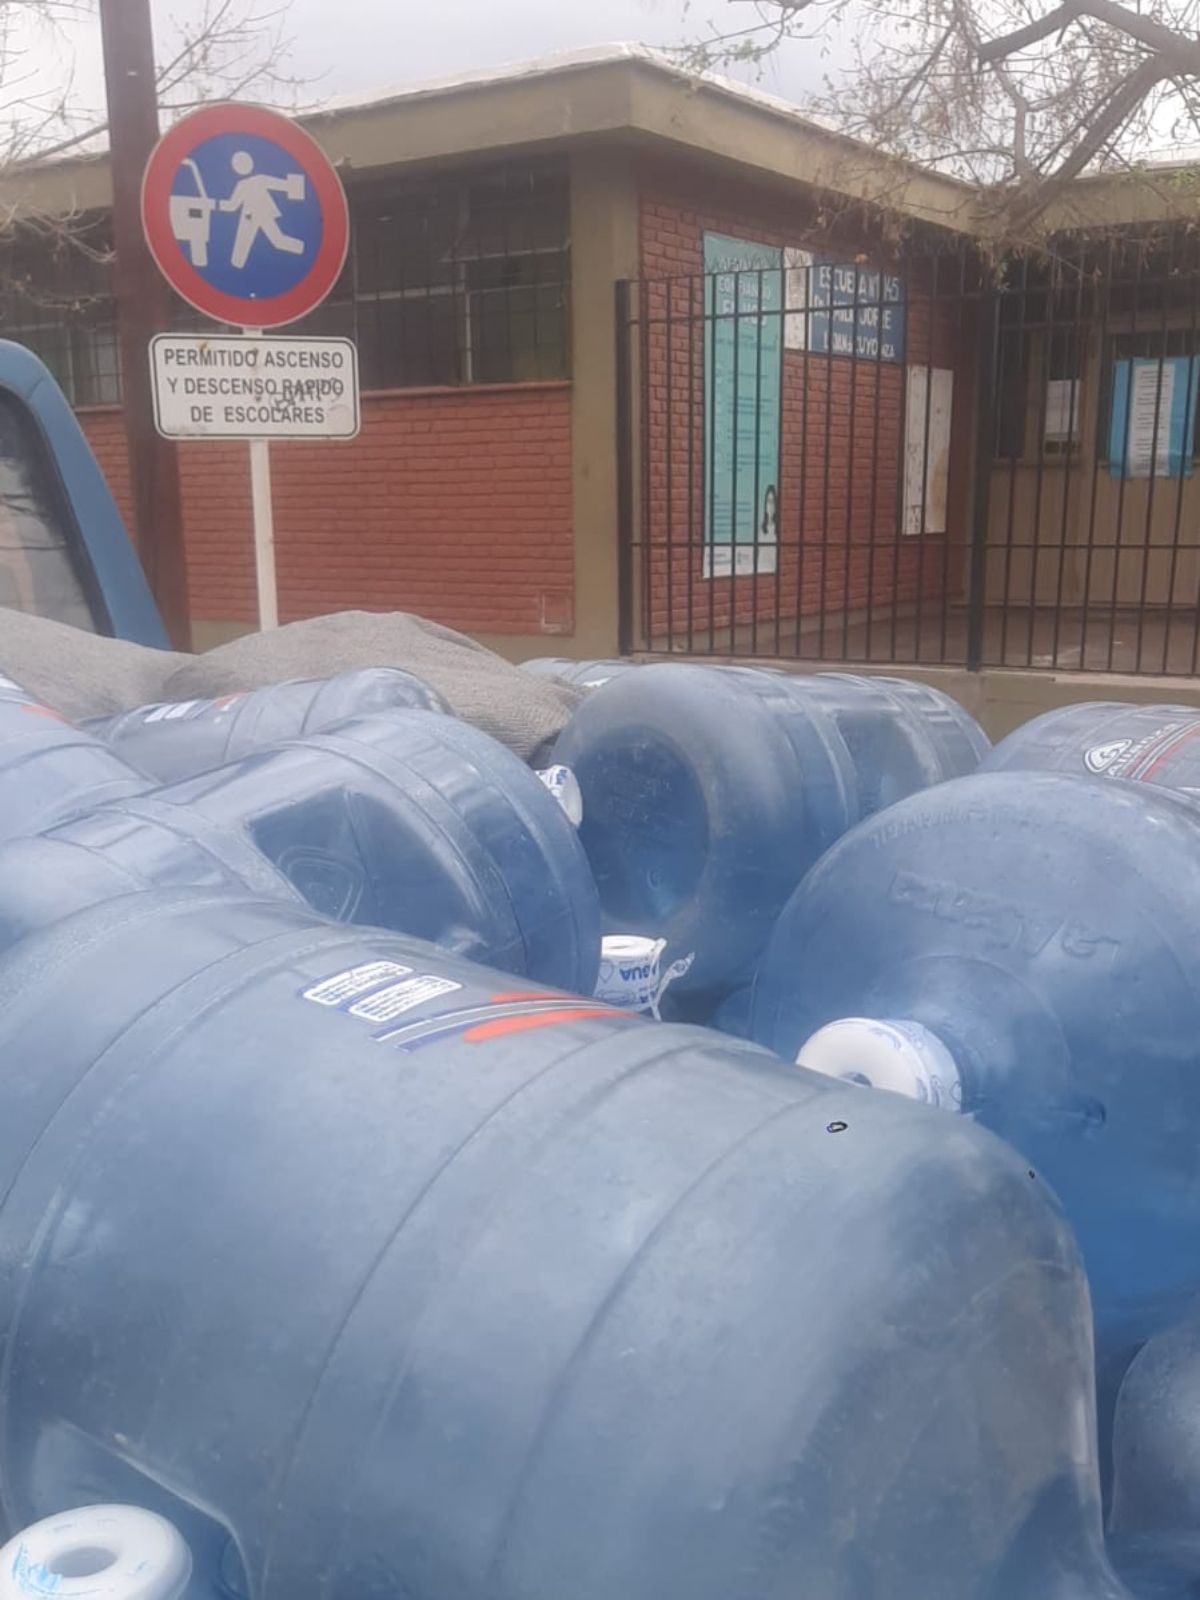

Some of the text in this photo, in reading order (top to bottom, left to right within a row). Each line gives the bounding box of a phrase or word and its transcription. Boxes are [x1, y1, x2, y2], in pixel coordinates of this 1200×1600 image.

[164, 348, 344, 369] PERMITIDO ASCENSO
[166, 377, 178, 393] Y
[184, 377, 277, 396] DESCENSO
[282, 378, 344, 396] RAPIDO
[190, 405, 325, 424] DE ESCOLARES
